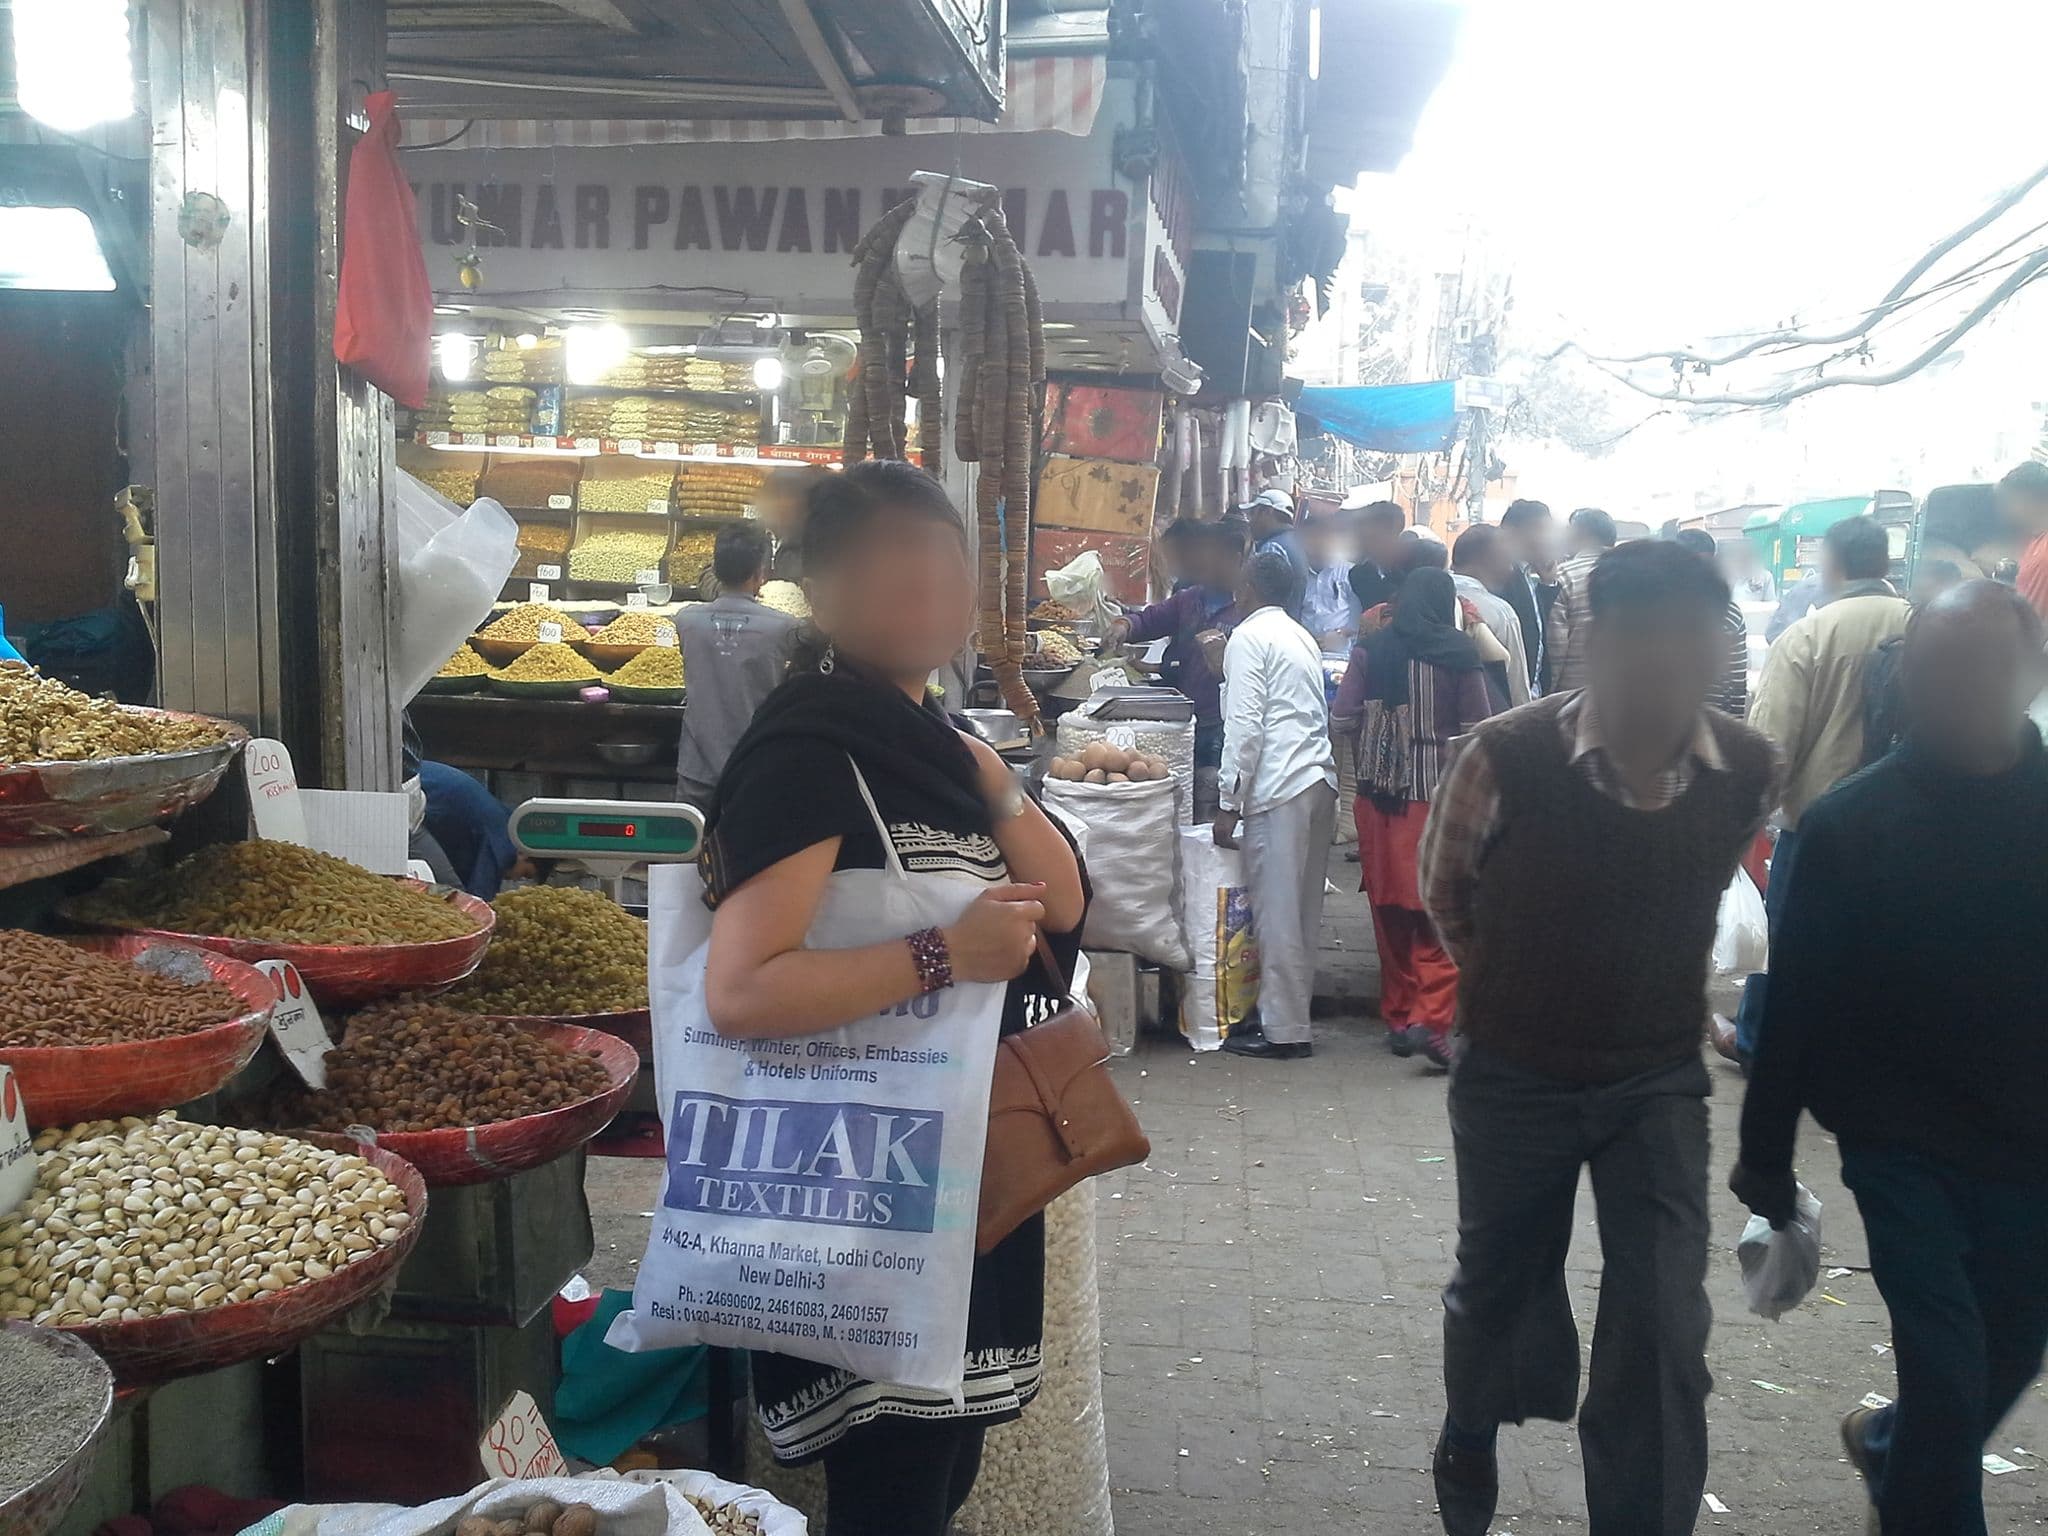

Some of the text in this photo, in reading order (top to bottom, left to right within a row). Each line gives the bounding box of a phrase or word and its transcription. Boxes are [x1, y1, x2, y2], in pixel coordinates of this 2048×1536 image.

[409, 182, 611, 249] UMAR
[634, 184, 861, 254] PAWAN
[246, 744, 281, 776] 200
[625, 823, 635, 836] 0
[806, 1042, 861, 1060] Offices,
[864, 1045, 949, 1064] Embassies
[744, 1060, 878, 1084] & Hotels Uniforms
[680, 1099, 932, 1187] TILAK
[695, 1176, 893, 1224] TEXTILES
[710, 1238, 765, 1259] Khanna
[769, 1242, 822, 1267] Market,
[827, 1247, 868, 1268] Lodhi
[872, 1251, 925, 1275] Colony
[739, 1265, 826, 1290] New Delhi-3
[706, 1290, 764, 1313] 24690602,
[767, 1298, 828, 1321] 24616083,
[831, 1304, 889, 1323] 24601557
[651, 1301, 676, 1320] Resi
[767, 1318, 820, 1340] 4344789,
[848, 1328, 919, 1349] 9818371951
